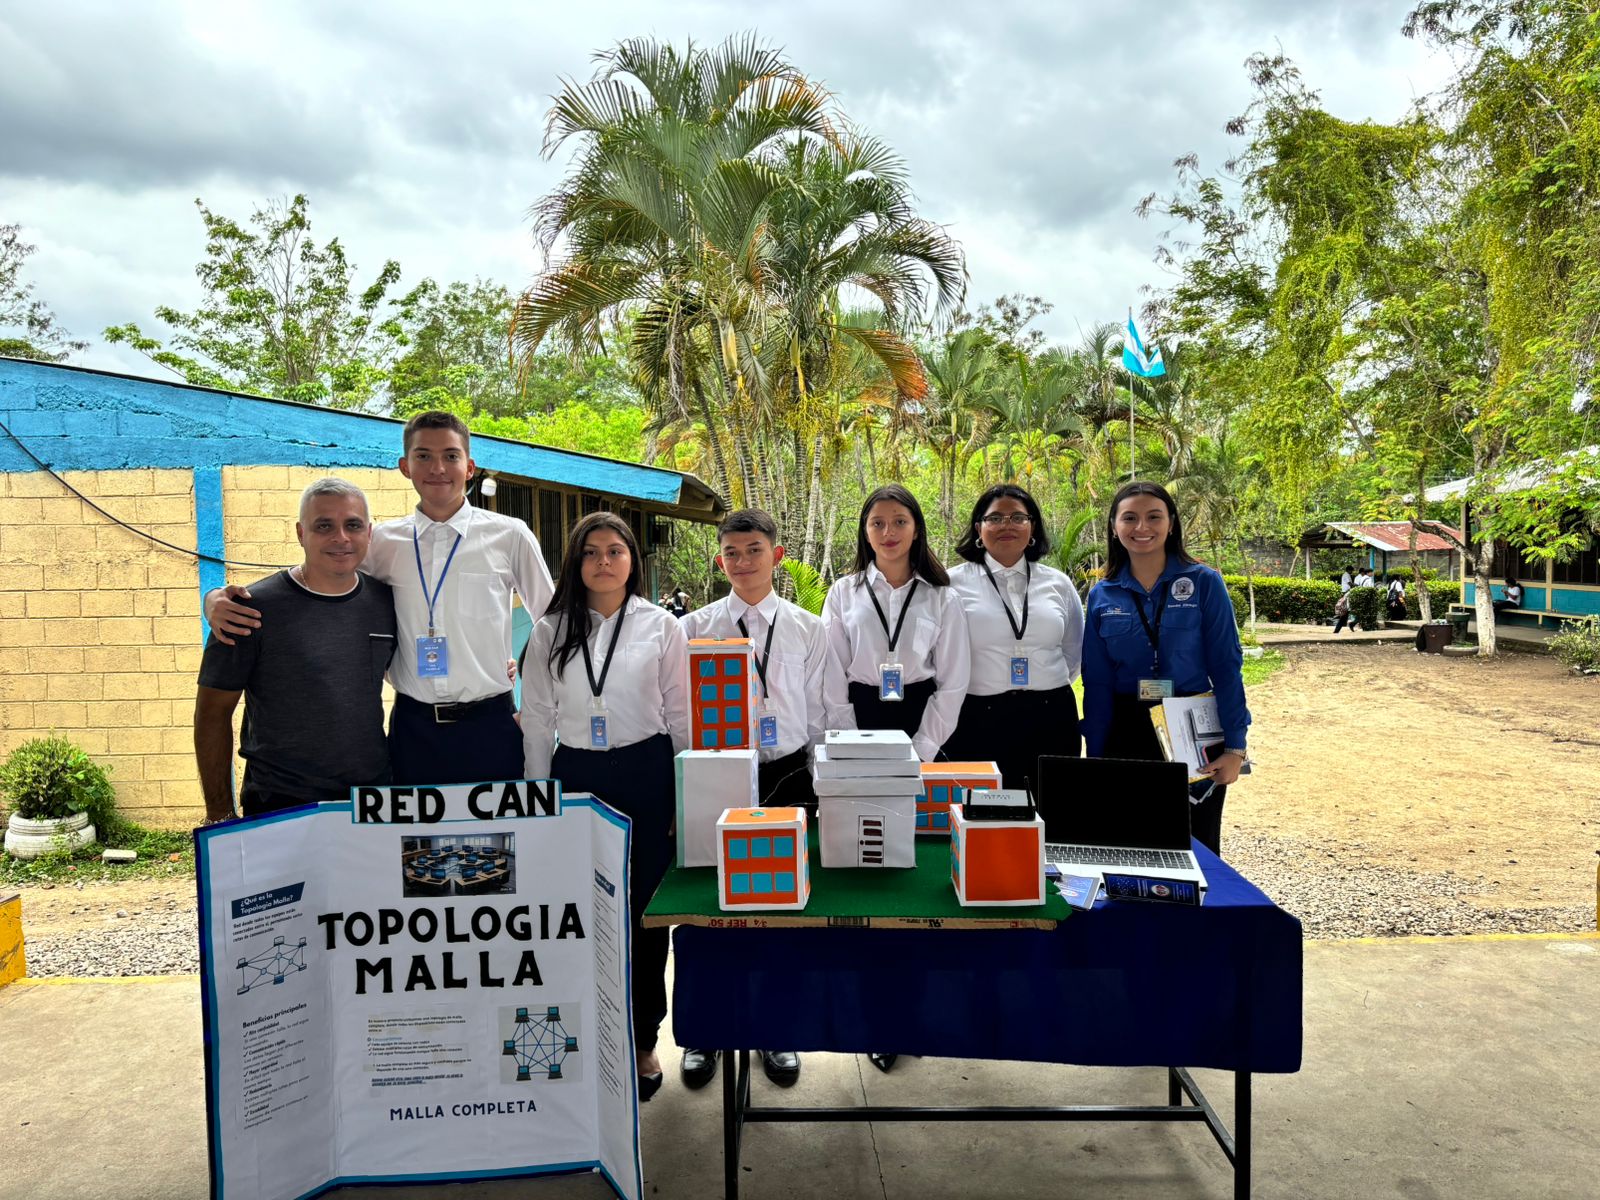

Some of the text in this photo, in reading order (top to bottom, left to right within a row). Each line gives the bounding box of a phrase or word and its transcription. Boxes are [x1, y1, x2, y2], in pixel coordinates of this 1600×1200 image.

[358, 780, 556, 824] RED CAN
[318, 902, 586, 951] TOPOLOGIA
[727, 919, 747, 928] REF
[356, 950, 544, 995] MALLA
[242, 1003, 307, 1028] Beneficios principales
[389, 1099, 537, 1121] MALLA COMPLETA
